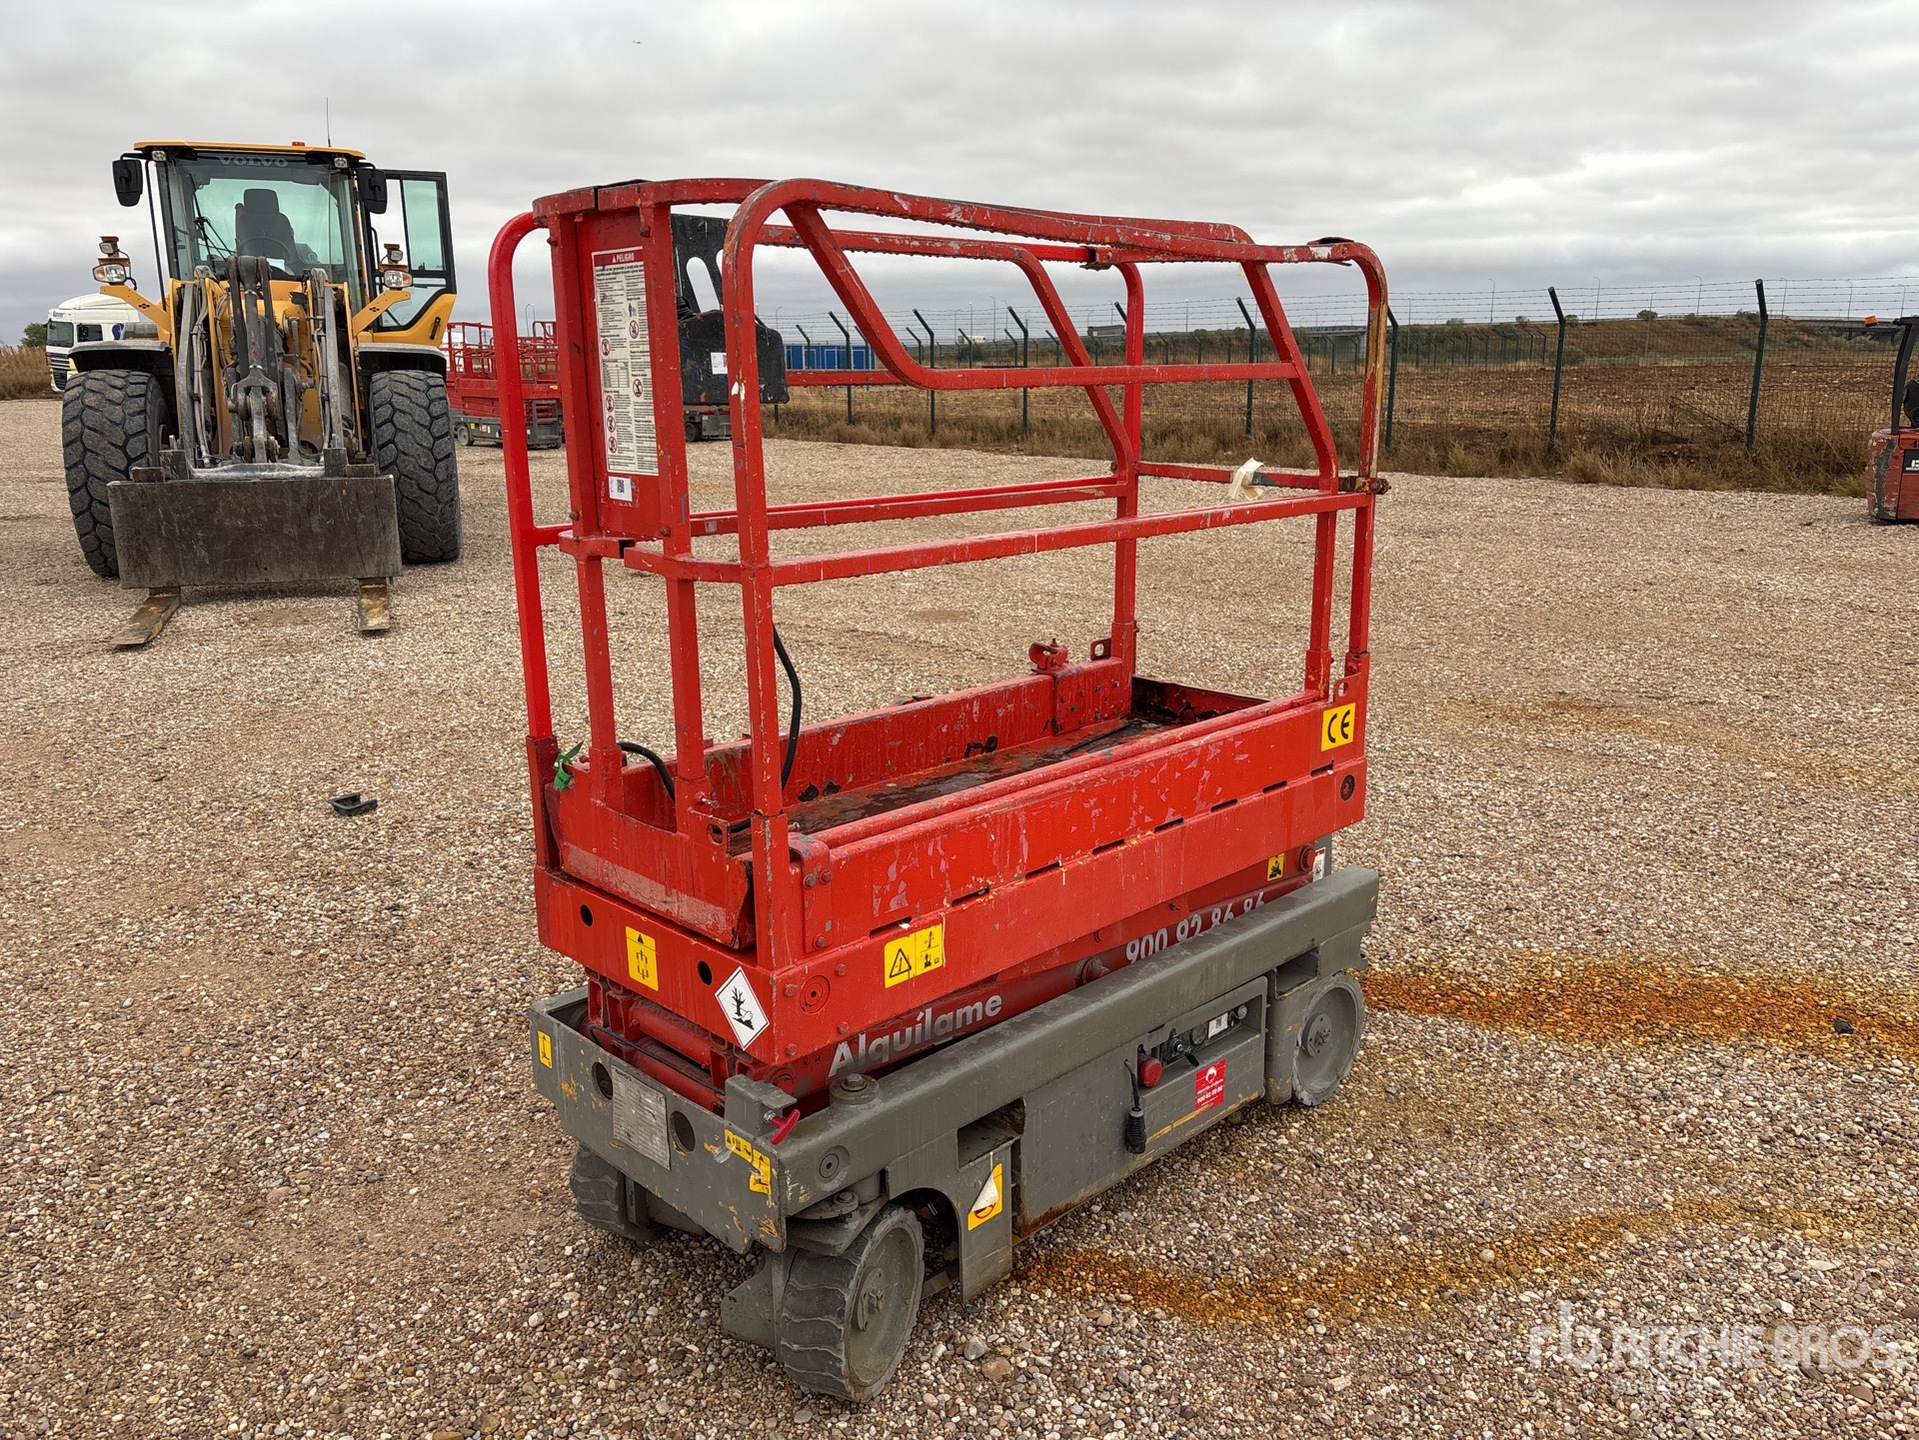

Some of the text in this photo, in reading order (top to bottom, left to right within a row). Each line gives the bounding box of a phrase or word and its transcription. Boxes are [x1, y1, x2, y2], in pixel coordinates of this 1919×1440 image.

[216, 156, 289, 168] VOLVO
[616, 252, 635, 263] PELIGRO
[1327, 709, 1351, 744] CE
[1126, 927, 1168, 964] 900
[828, 994, 1003, 1078] Alquílame
